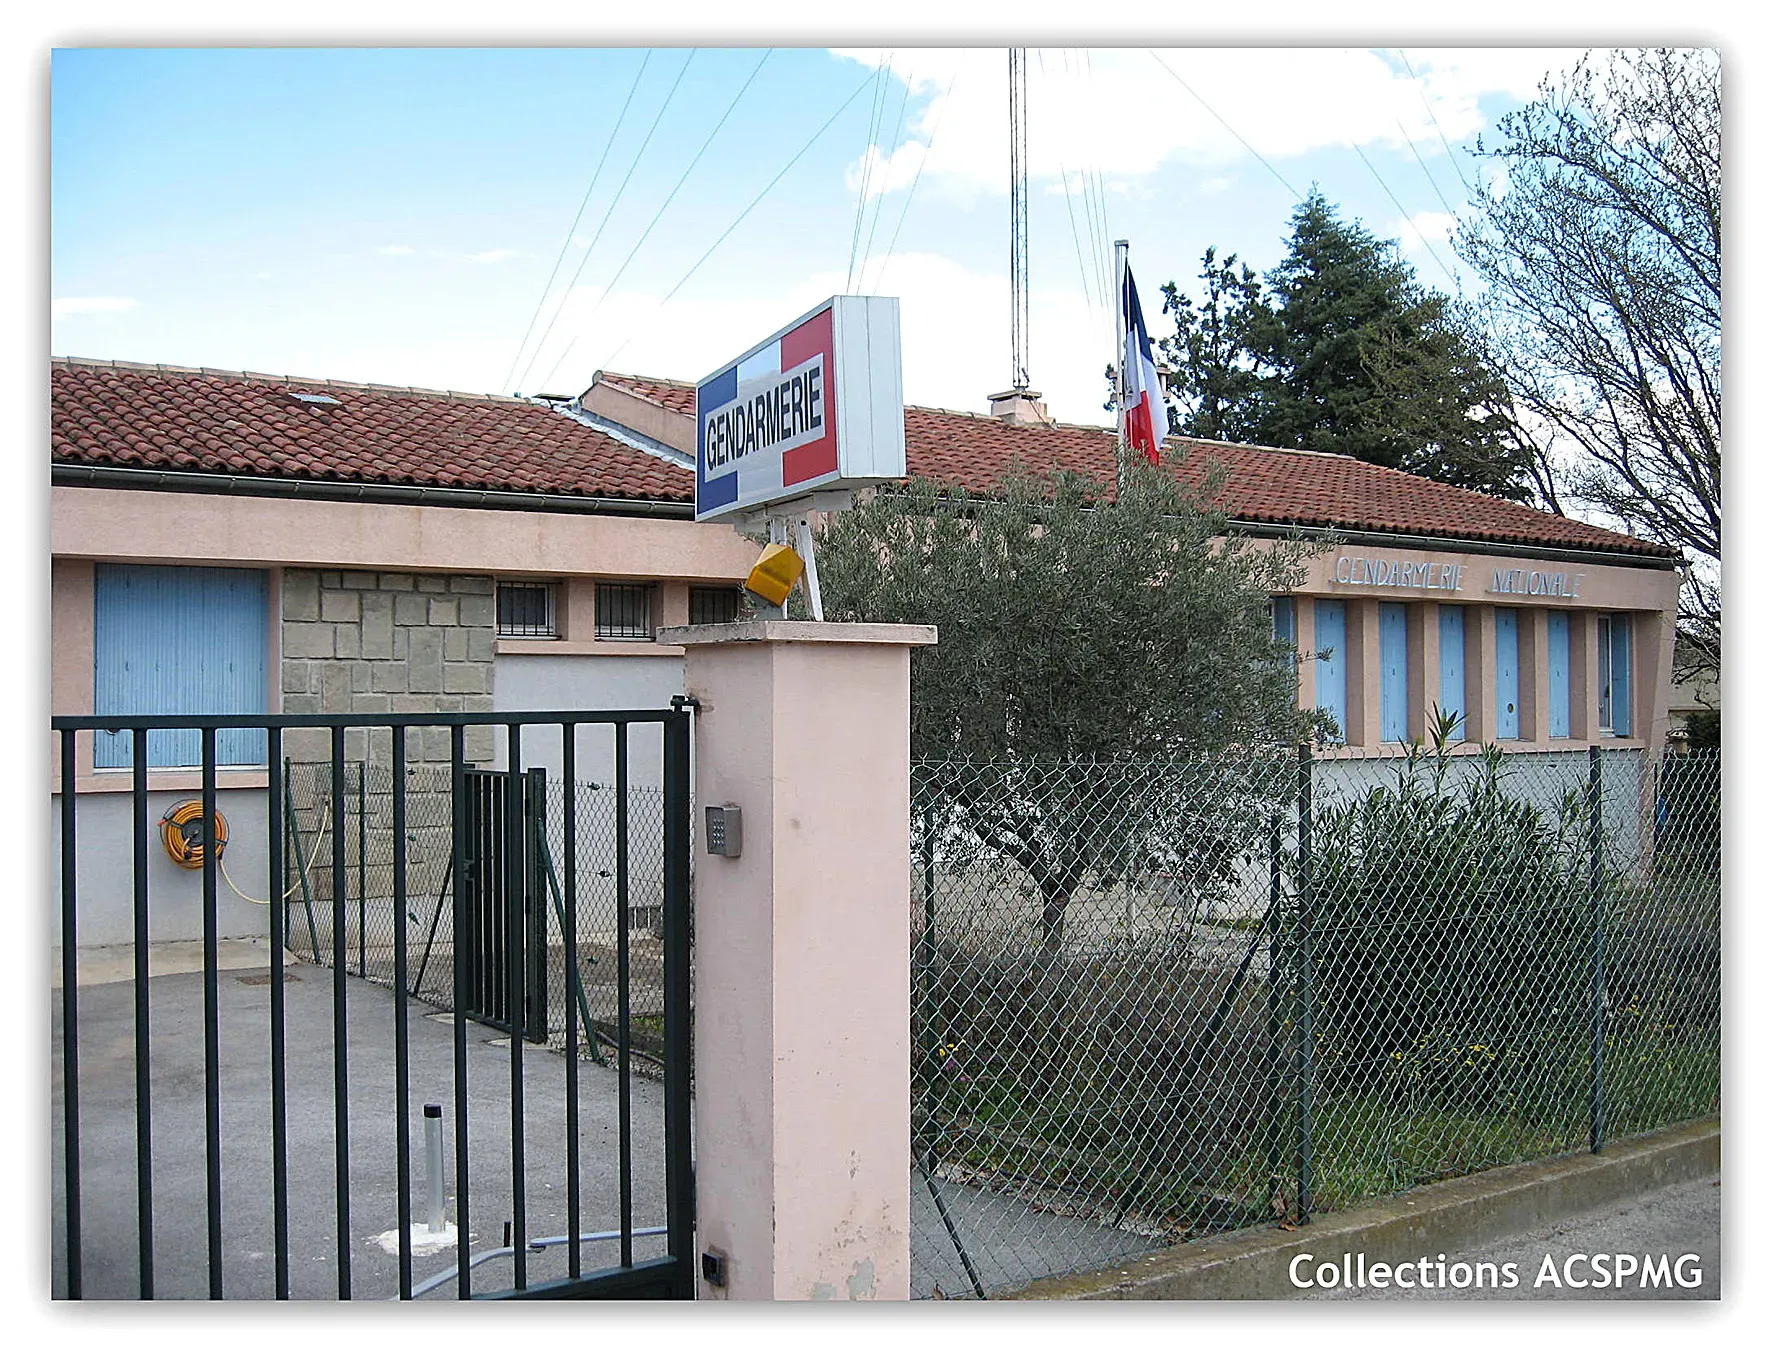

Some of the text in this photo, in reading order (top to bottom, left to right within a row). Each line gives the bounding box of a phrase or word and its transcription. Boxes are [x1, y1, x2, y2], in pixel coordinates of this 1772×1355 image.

[707, 366, 822, 471] GENDARMERIE
[1335, 556, 1585, 598] GENDARMERIE NATIONALE
